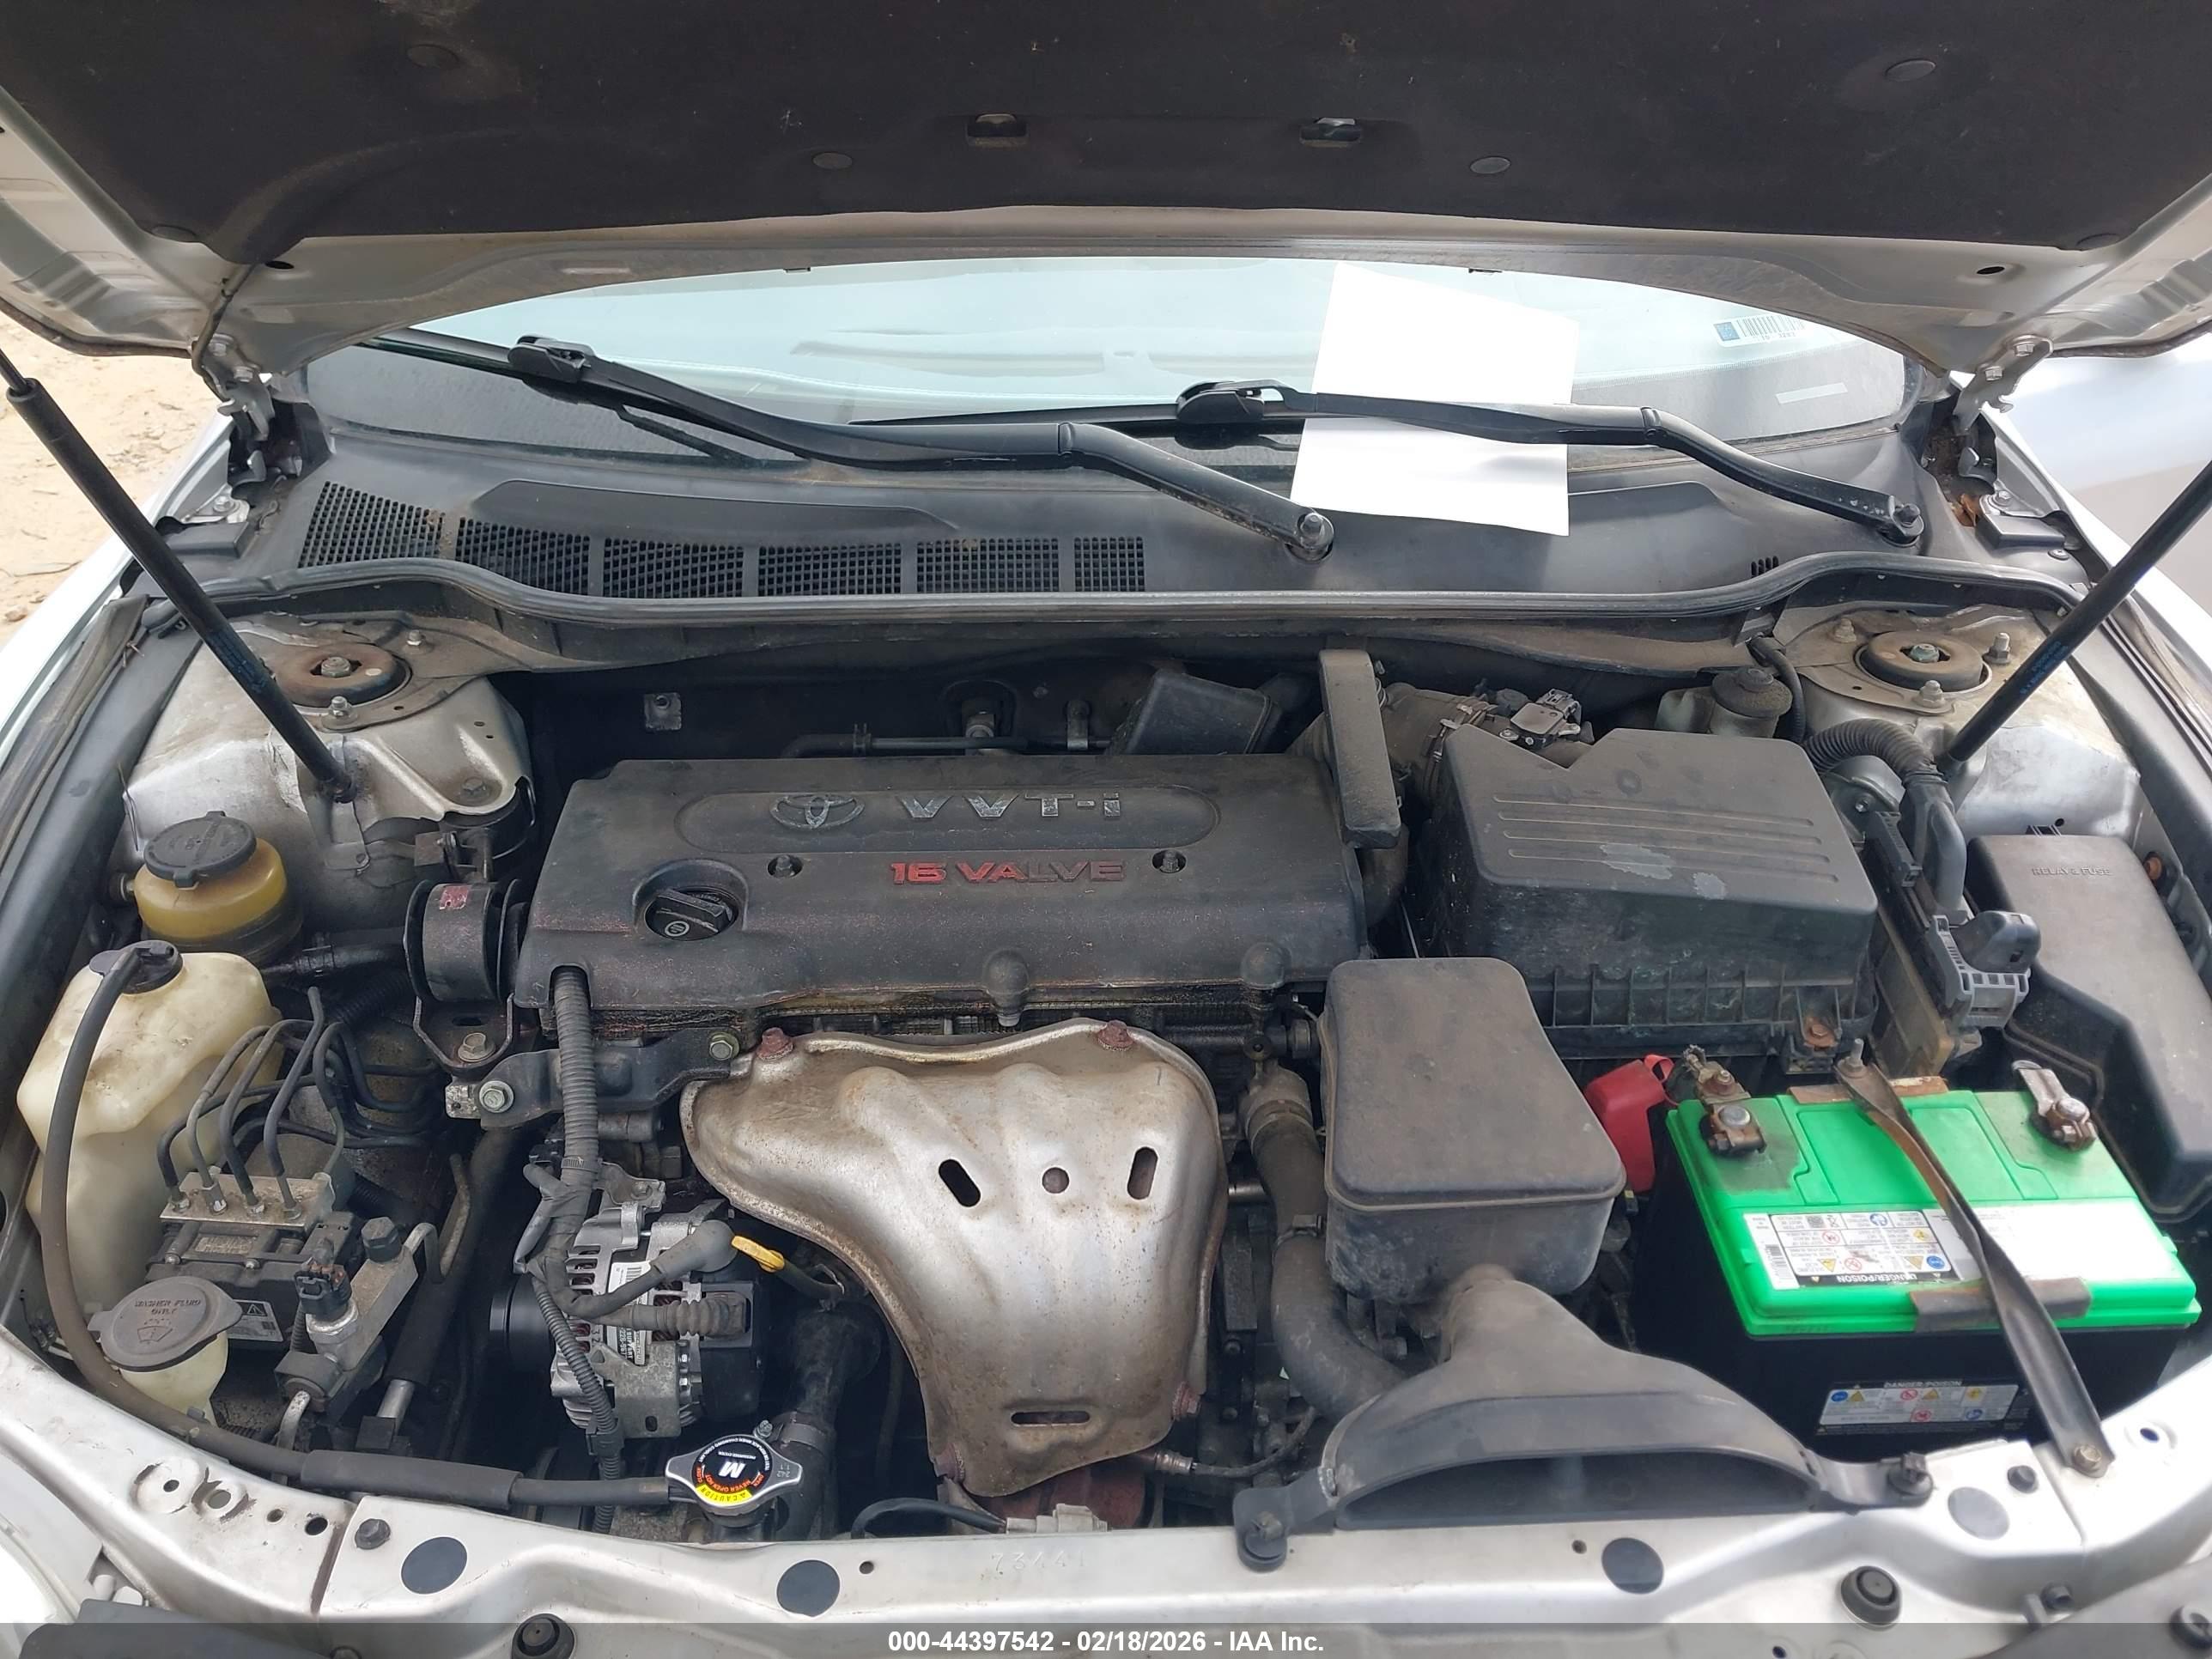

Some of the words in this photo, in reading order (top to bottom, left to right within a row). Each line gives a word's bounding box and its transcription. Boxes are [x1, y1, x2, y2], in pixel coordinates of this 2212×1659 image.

[899, 792, 1121, 818] VVT-i
[890, 863, 945, 884] 16
[956, 861, 1126, 884] VALVE
[134, 1298, 172, 1307] WASHER
[701, 1487, 738, 1502] CAUTION
